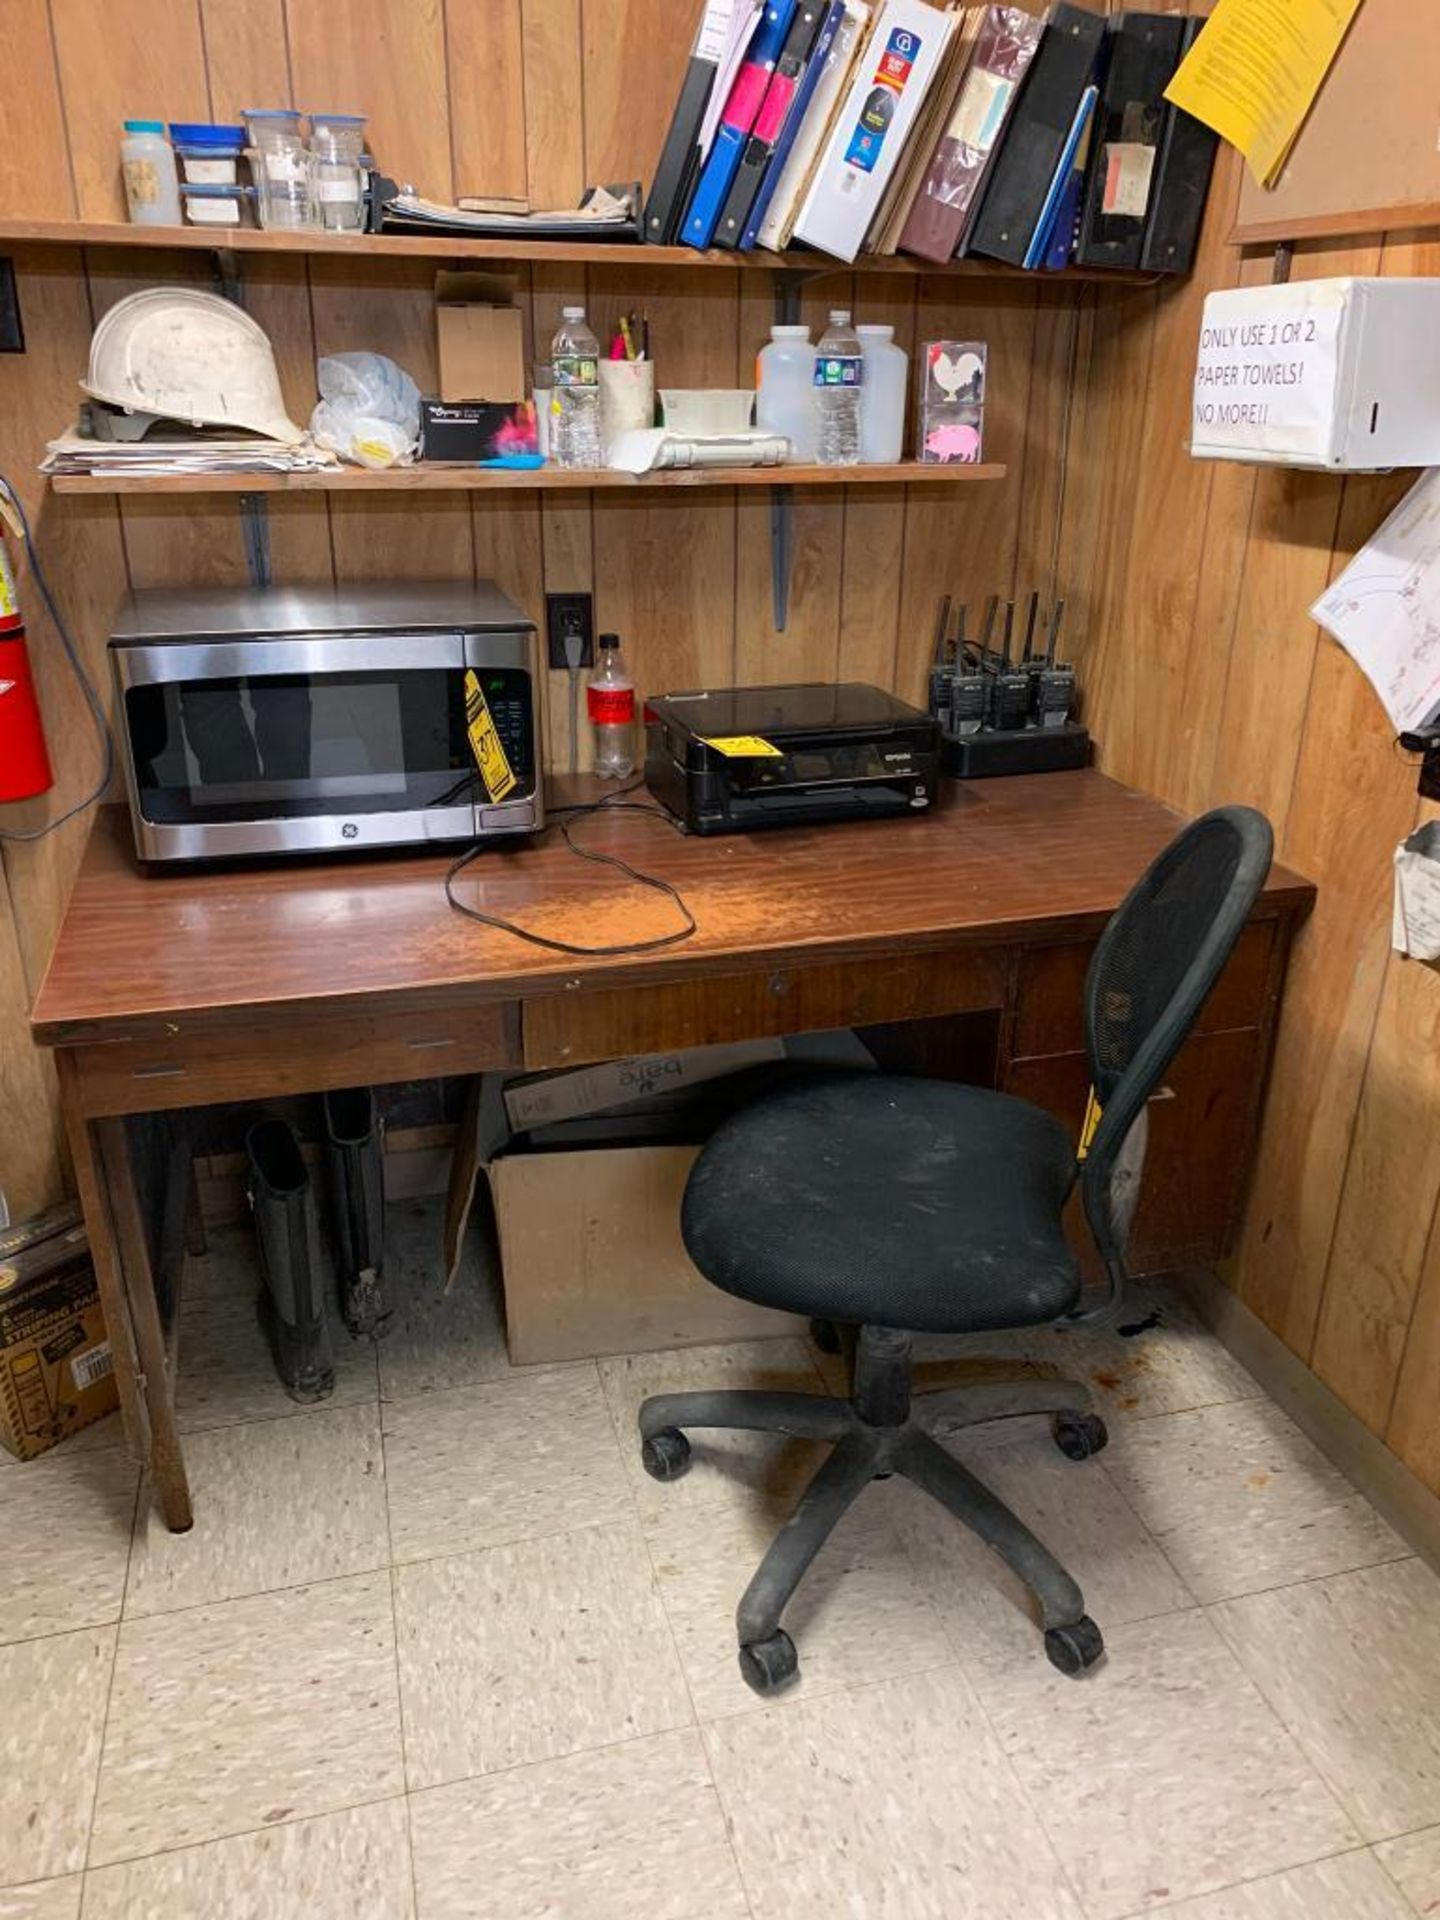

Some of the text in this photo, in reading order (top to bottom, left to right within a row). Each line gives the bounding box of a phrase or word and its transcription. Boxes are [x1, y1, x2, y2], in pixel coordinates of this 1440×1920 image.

[1201, 319, 1316, 348] ONLY USE 1 OR 2
[1198, 361, 1305, 386] PAPER TOWELS!
[1196, 403, 1269, 424] NO MORE!!
